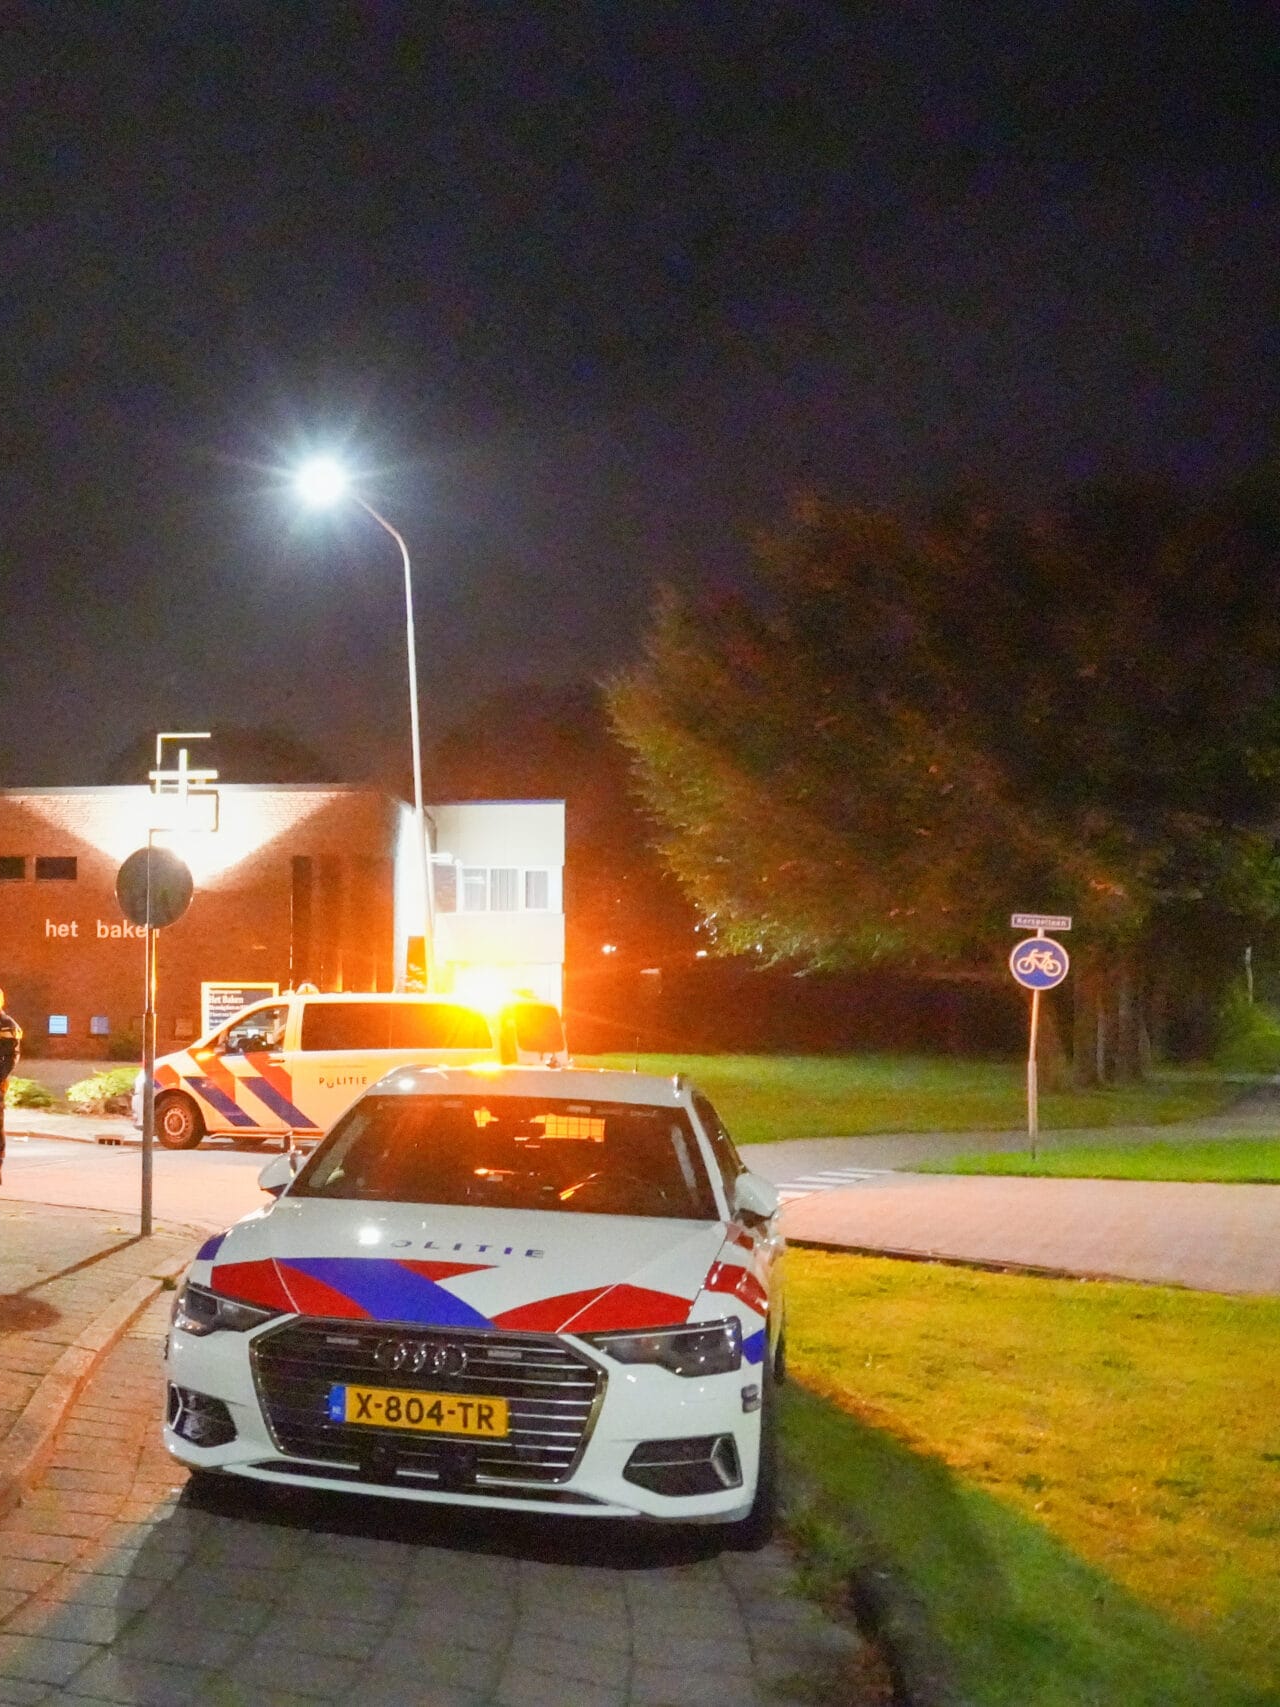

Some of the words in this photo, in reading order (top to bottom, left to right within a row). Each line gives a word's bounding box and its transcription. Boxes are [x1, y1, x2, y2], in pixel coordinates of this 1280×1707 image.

[45, 919, 79, 937] het
[390, 1239, 544, 1259] OLITIE
[355, 1392, 495, 1431] X-804-TR
